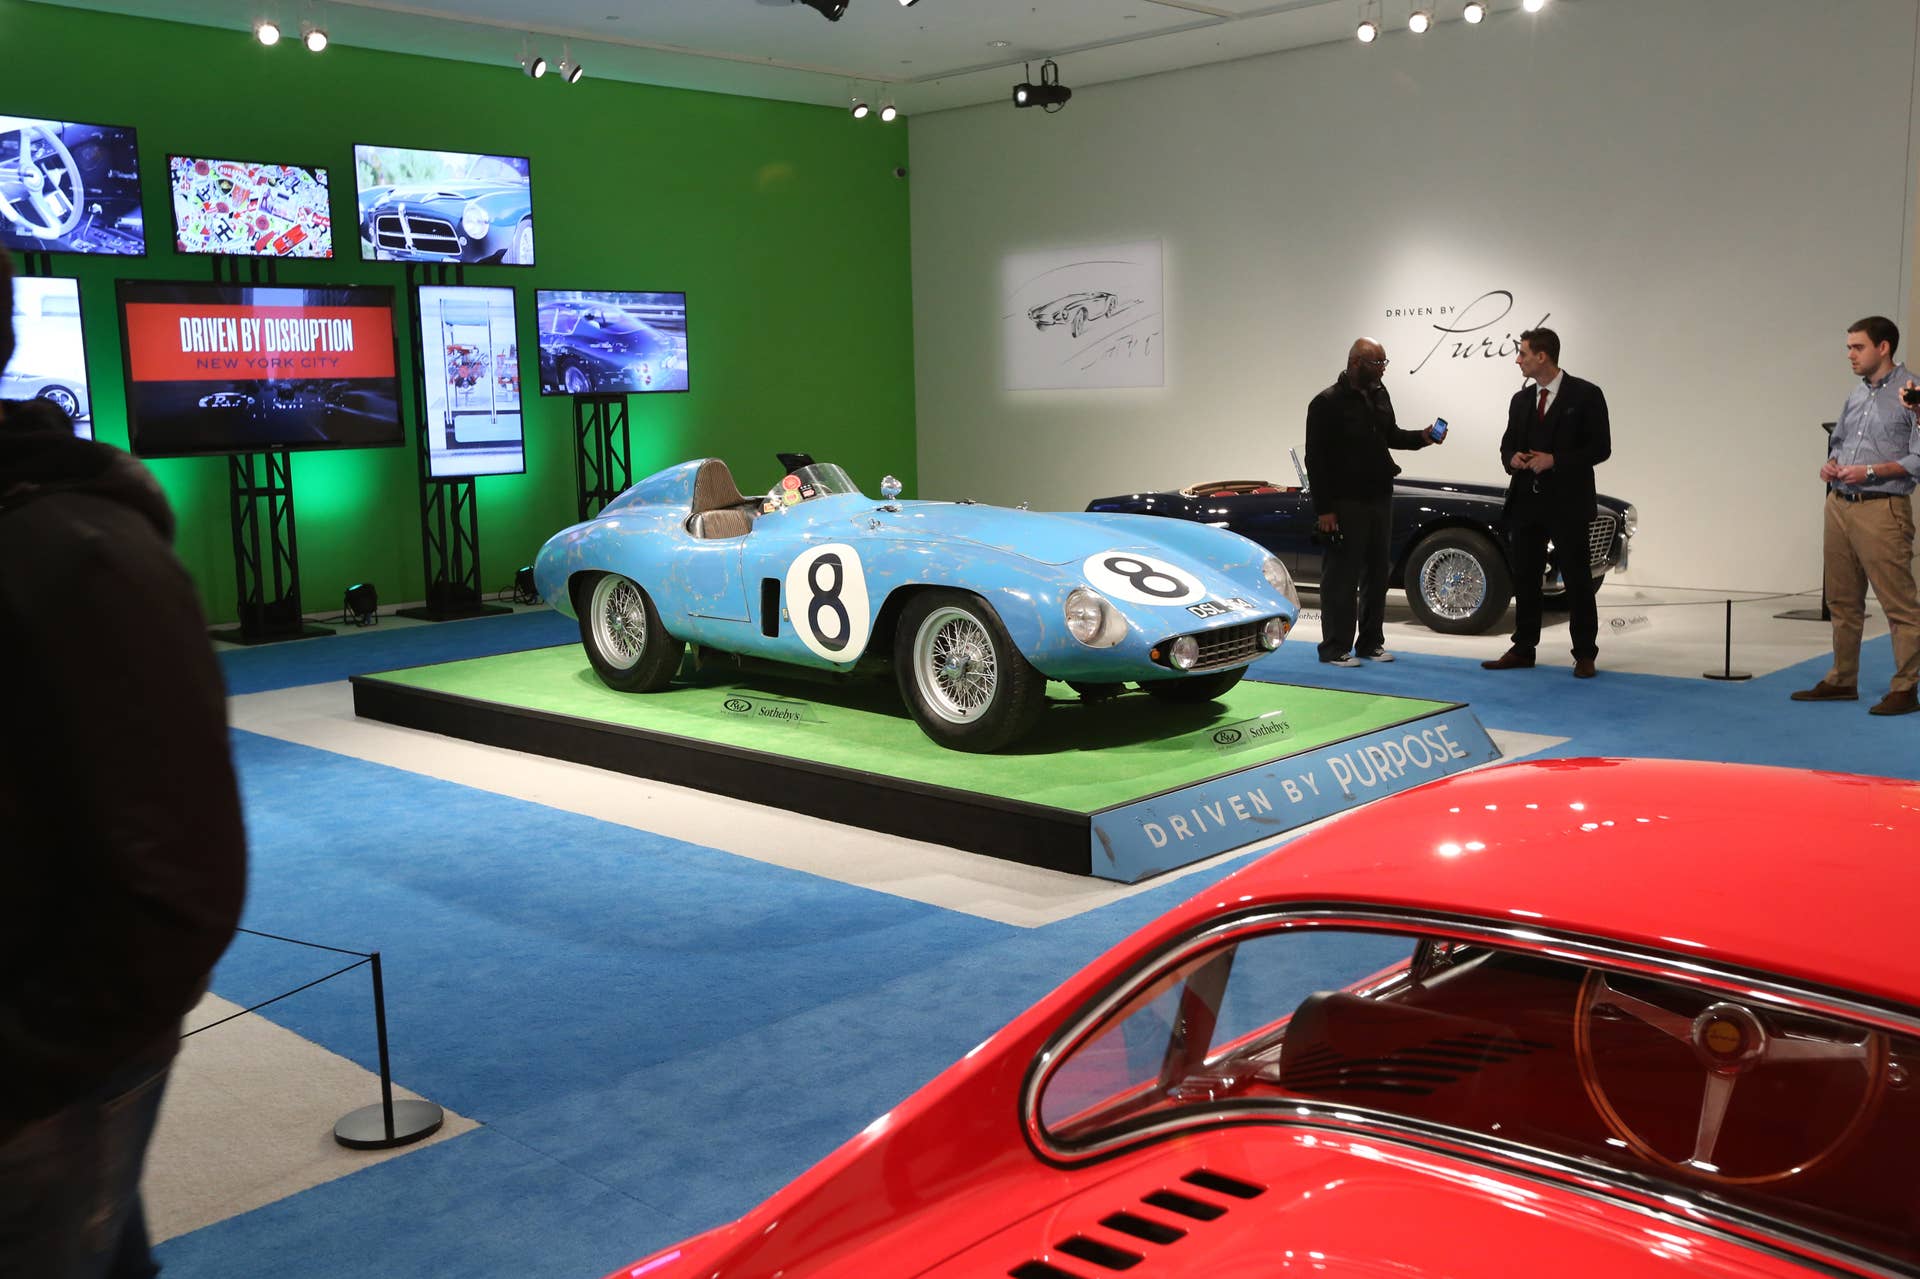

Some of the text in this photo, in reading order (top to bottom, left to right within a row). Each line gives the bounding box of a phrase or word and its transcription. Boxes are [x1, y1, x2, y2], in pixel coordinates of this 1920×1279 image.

[1386, 307, 1433, 317] DRIVEN
[1440, 305, 1456, 315] BY
[179, 317, 354, 353] DRIVEN BY DISRUPTION
[196, 357, 340, 369] NEW YORK CITY
[1103, 556, 1190, 599] 8
[807, 552, 851, 652] 8
[1188, 602, 1226, 618] DSL
[758, 706, 800, 721] Sotheby's
[1249, 720, 1290, 738] Sotheby's
[1143, 724, 1467, 848] DRIVEN BY PURPOSE
